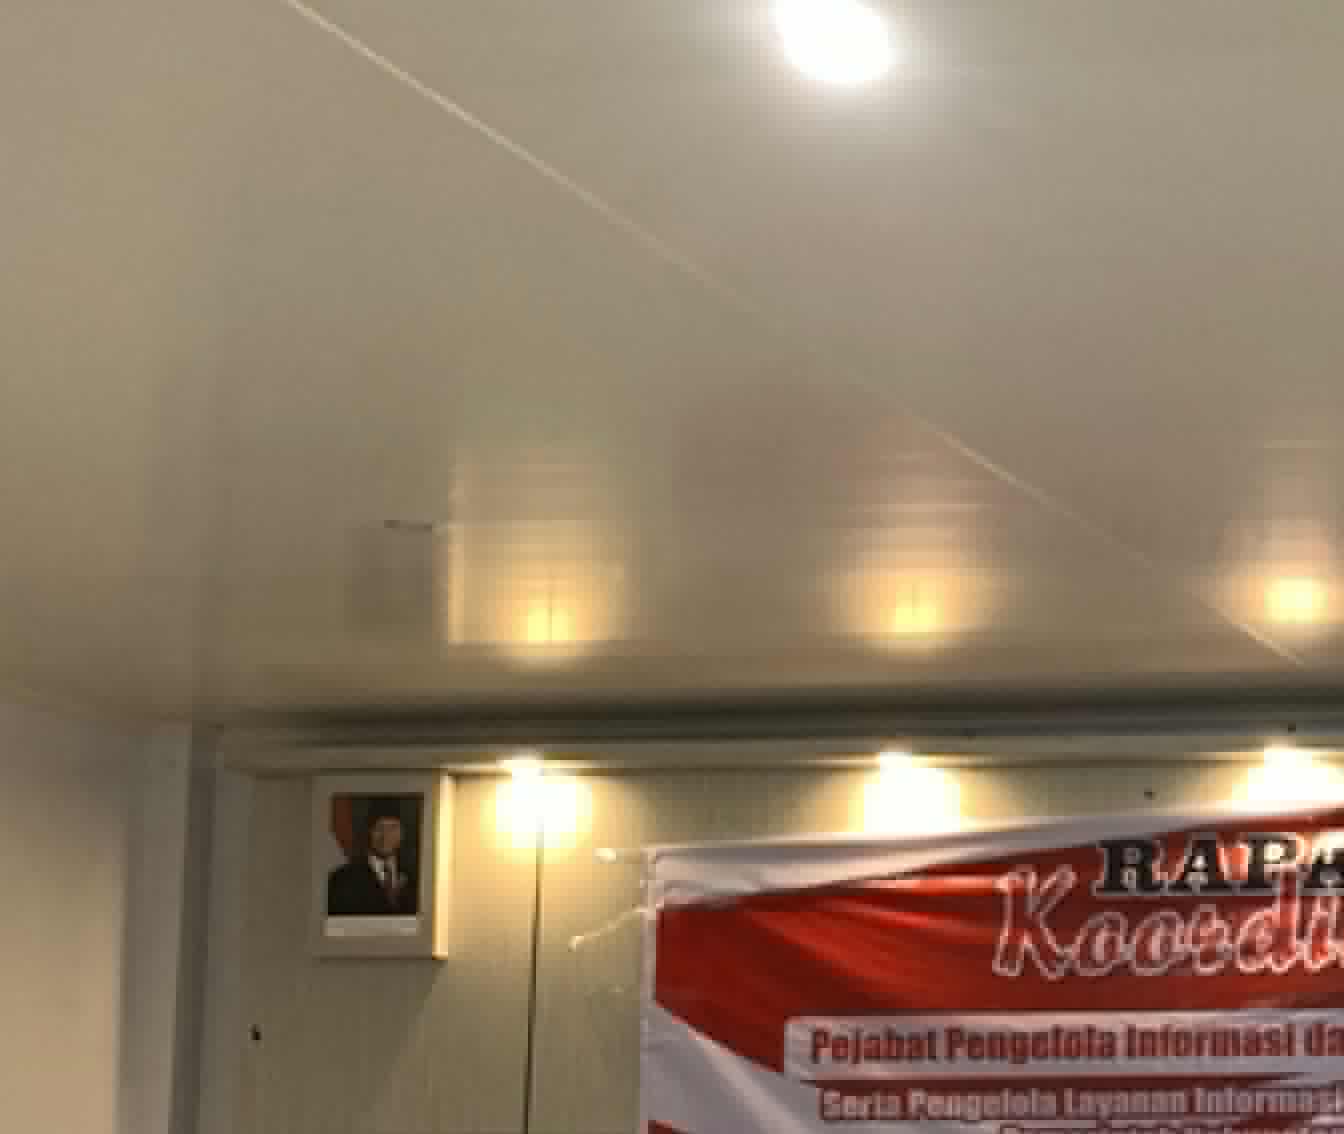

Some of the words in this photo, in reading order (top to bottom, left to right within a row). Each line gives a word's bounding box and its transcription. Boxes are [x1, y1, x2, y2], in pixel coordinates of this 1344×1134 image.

[811, 1027, 939, 1064] Pejabat
[946, 1024, 1118, 1063] Pengelola
[1126, 1022, 1294, 1059] Informasi
[820, 1088, 901, 1119] Serta
[907, 1087, 1057, 1121] Pengelola
[1064, 1086, 1187, 1121] Layanan
[1195, 1082, 1344, 1117] Informasi
